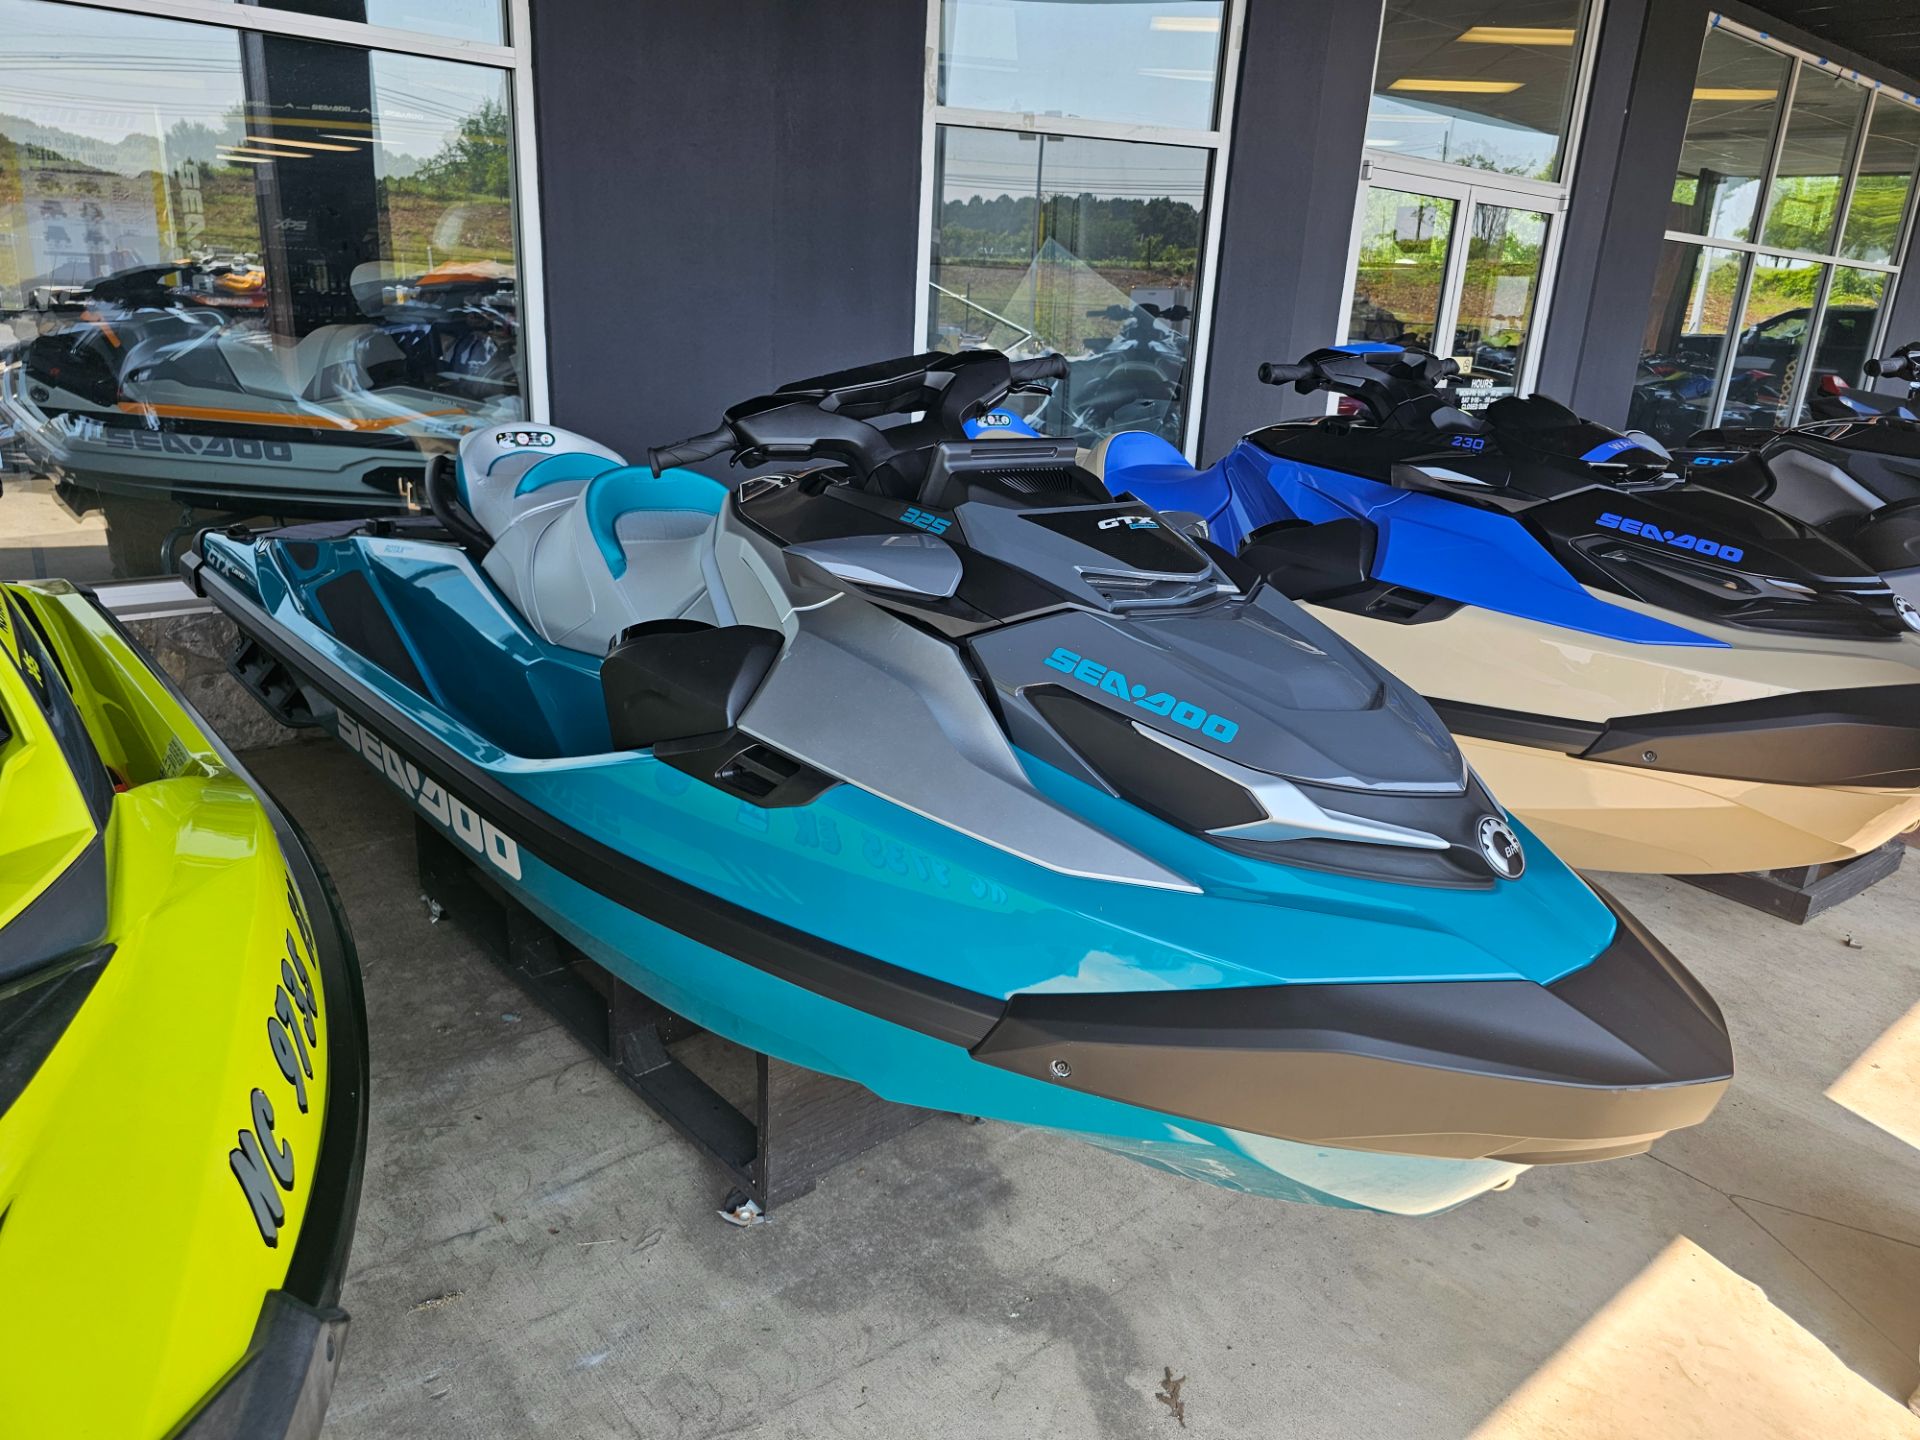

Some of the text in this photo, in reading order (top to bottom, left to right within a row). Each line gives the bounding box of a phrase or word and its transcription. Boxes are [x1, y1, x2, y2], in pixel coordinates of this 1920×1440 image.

[1471, 379, 1494, 388] HOURS
[1451, 436, 1485, 450] 230
[900, 507, 952, 535] 325
[1097, 516, 1157, 530] GTX
[207, 548, 230, 577] GTX
[229, 1087, 295, 1249] NC
